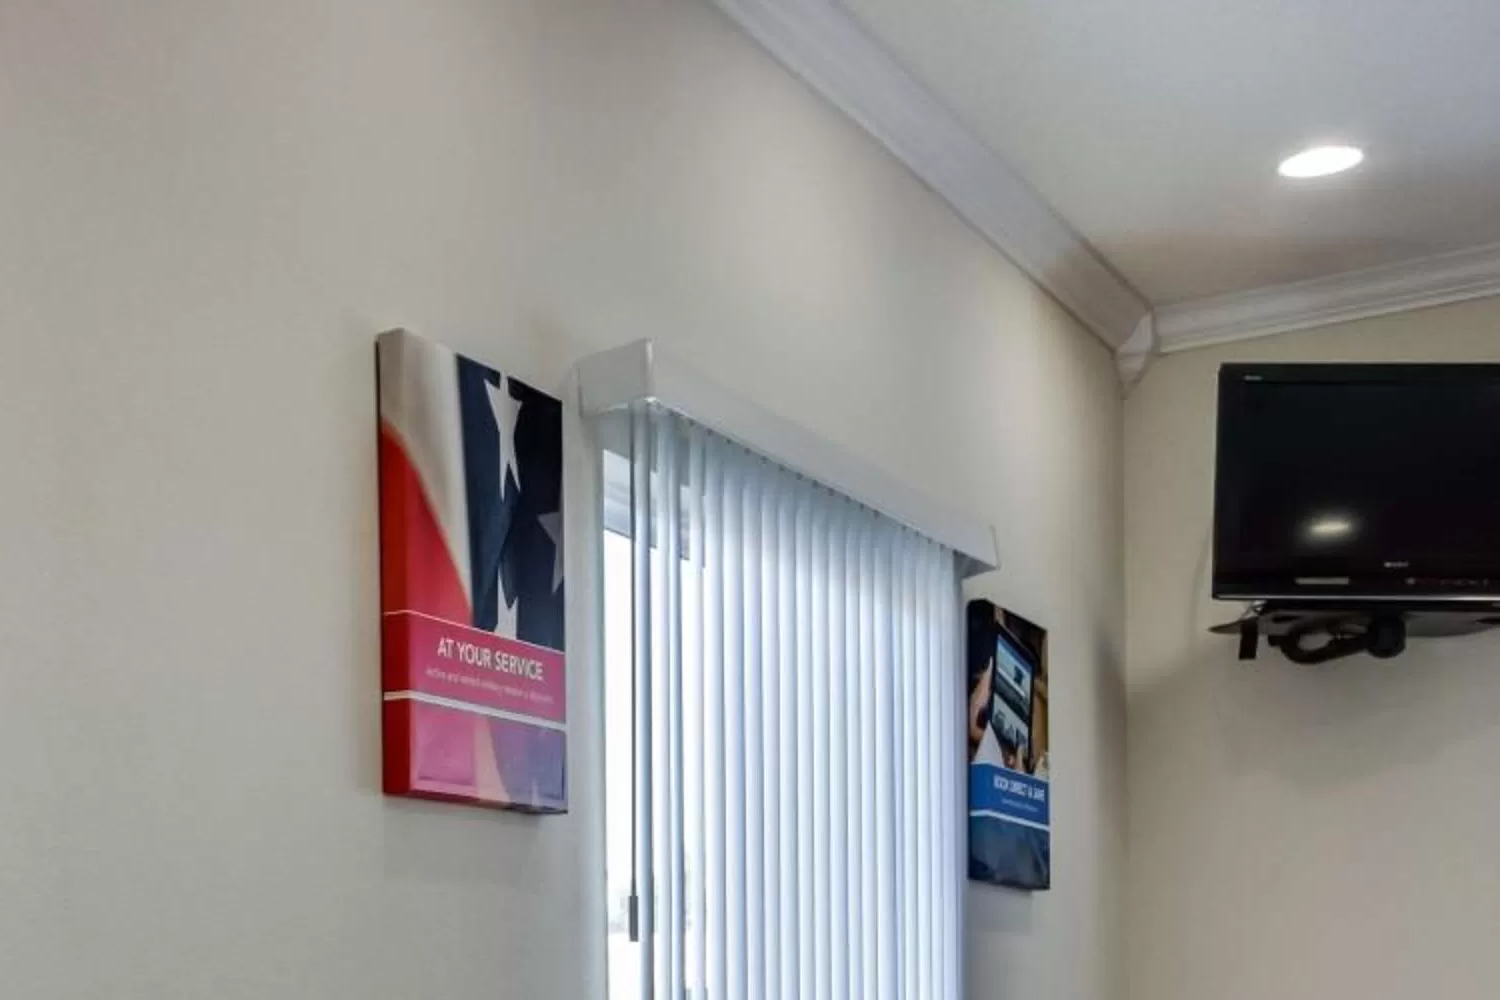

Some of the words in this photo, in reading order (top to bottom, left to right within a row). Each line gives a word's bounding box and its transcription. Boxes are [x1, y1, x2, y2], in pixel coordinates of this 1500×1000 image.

[437, 637, 454, 658] AT
[456, 641, 492, 670] YOUR
[495, 650, 544, 681] SERVICE
